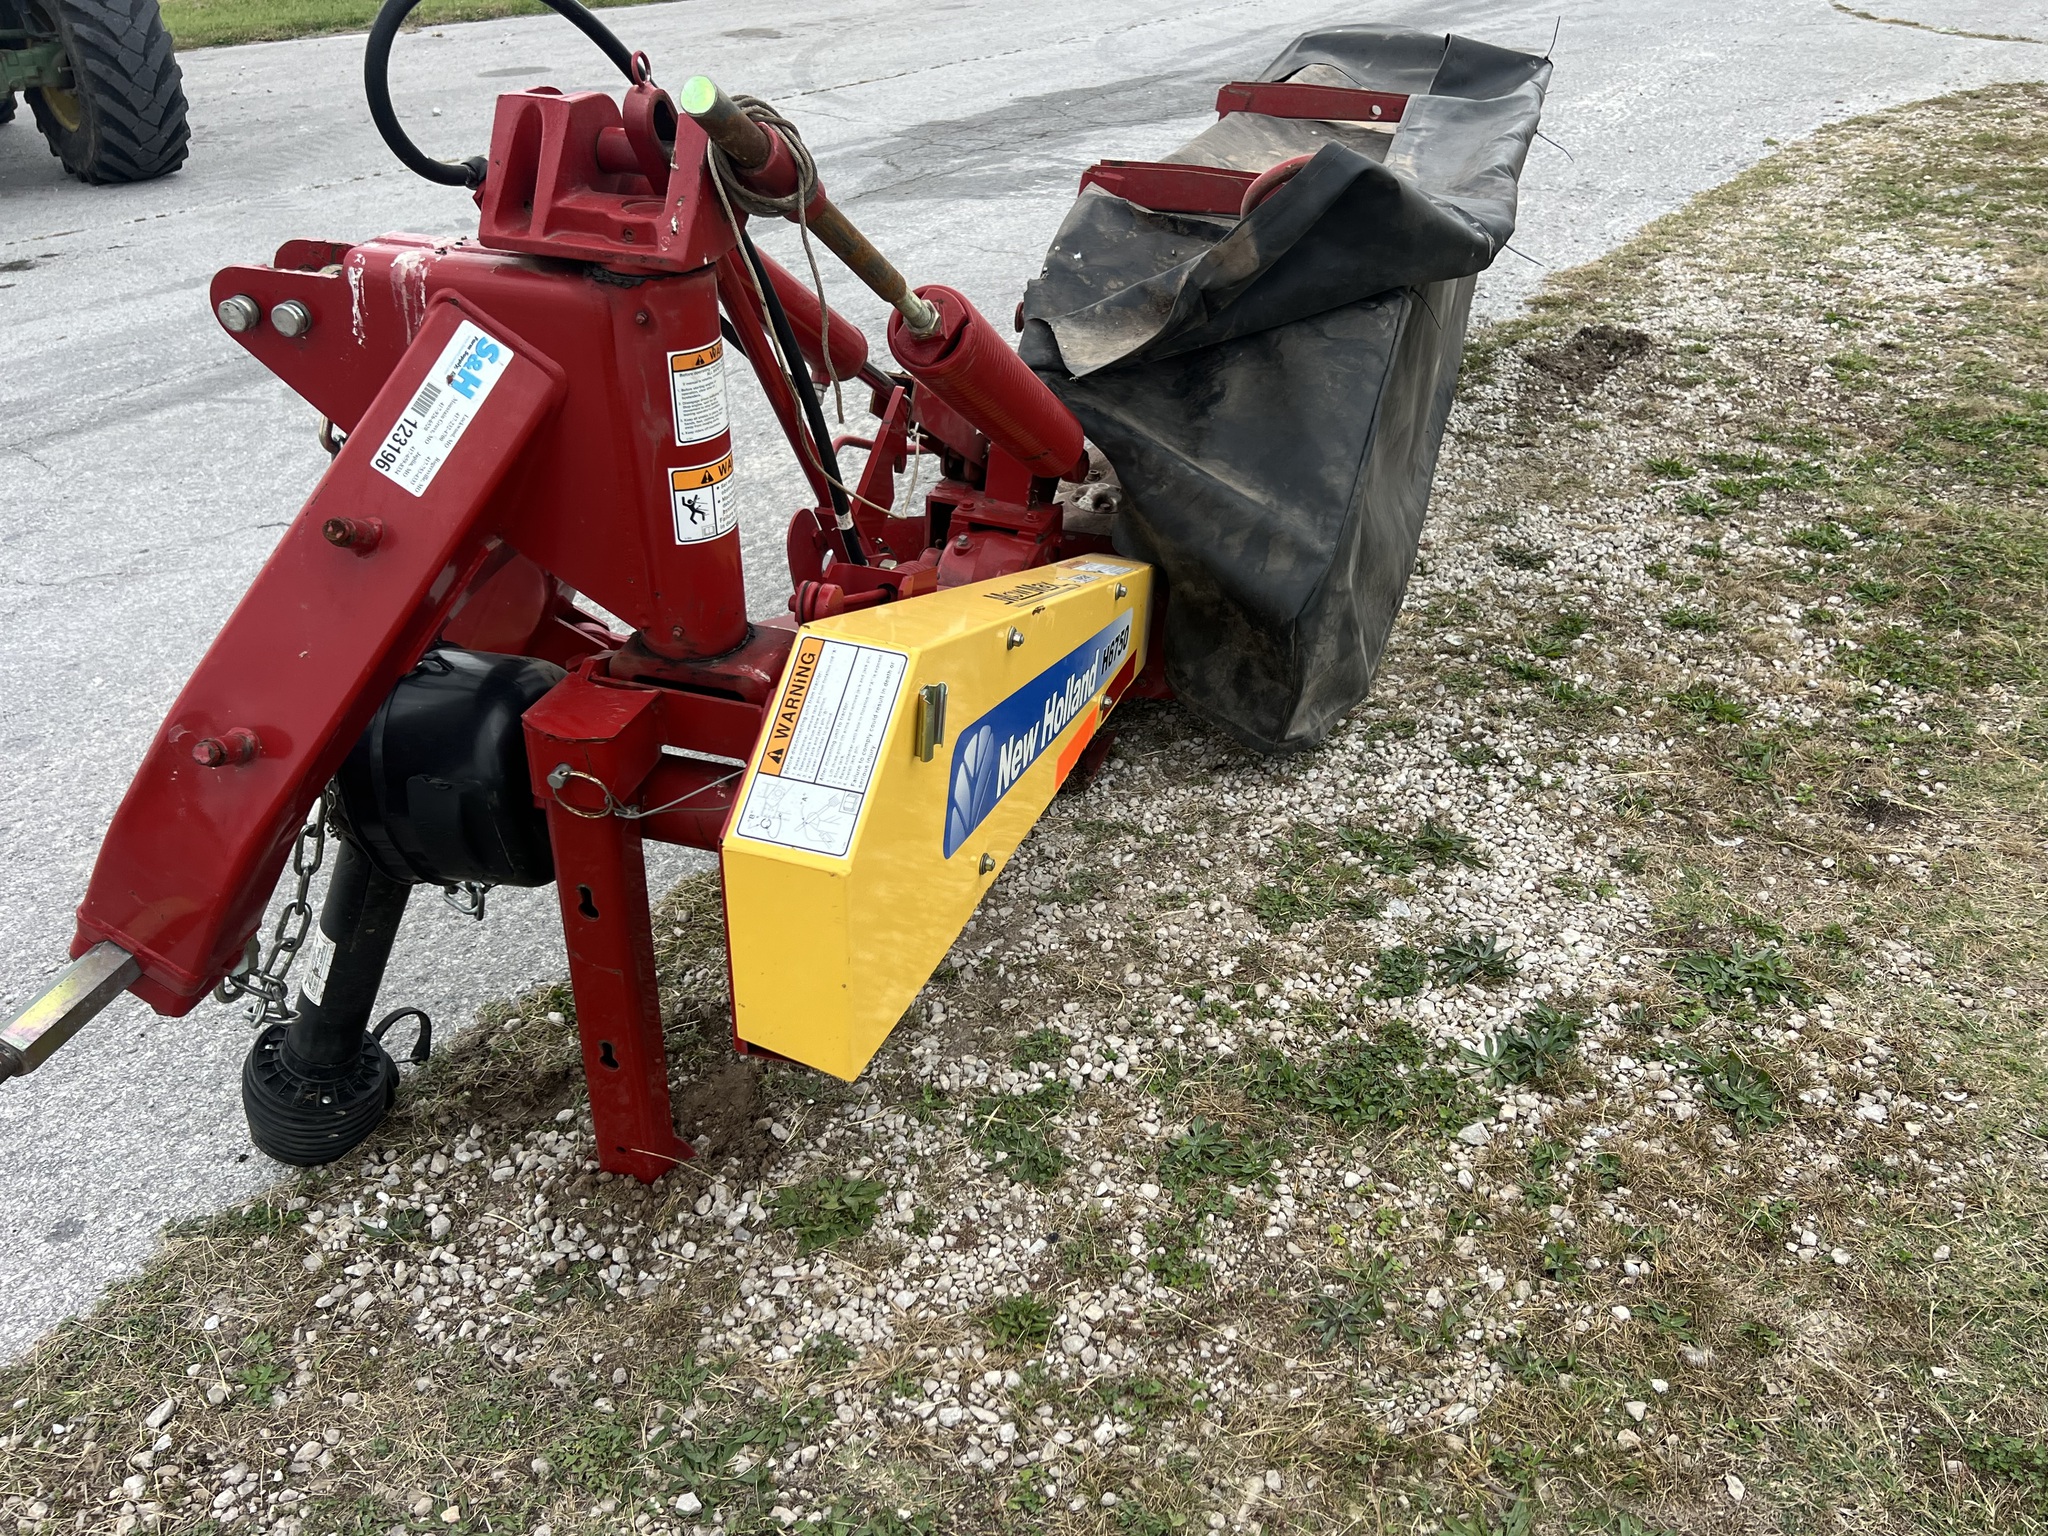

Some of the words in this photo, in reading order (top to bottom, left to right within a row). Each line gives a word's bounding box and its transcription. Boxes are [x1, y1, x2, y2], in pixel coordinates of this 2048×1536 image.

[451, 336, 500, 400] S&H
[439, 396, 458, 421] Mountain
[449, 413, 469, 439] Lockwood,
[375, 417, 418, 472] 123196
[423, 433, 434, 445] MO
[442, 437, 453, 449] MO
[400, 466, 411, 478] MO
[413, 481, 424, 493] MO
[888, 660, 897, 669] or
[882, 668, 894, 687] death
[774, 651, 817, 740] WARNING
[880, 687, 888, 695] in
[873, 694, 885, 713] result
[996, 720, 1040, 799] New
[1040, 648, 1100, 749] Holland
[1101, 624, 1130, 675] H6750
[867, 713, 879, 732] could
[859, 732, 873, 756] comply
[857, 756, 865, 764] to
[849, 764, 862, 787] Failure
[856, 764, 870, 788] serious
